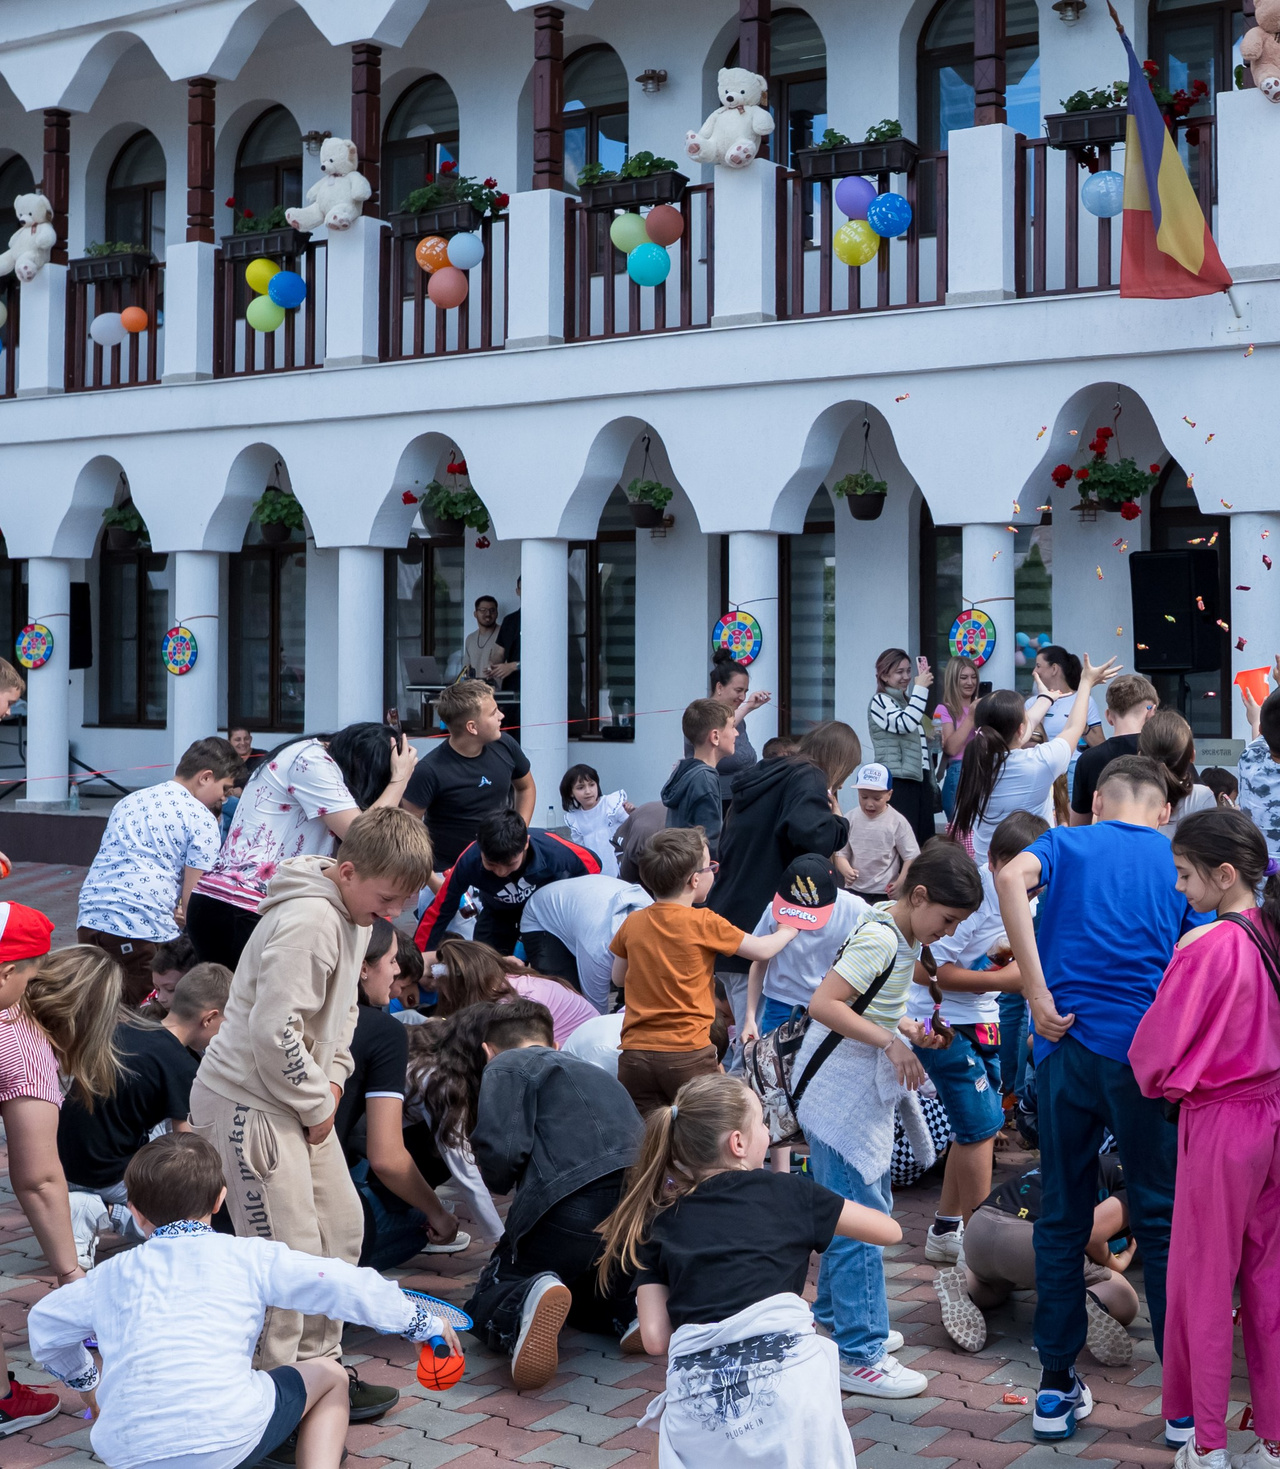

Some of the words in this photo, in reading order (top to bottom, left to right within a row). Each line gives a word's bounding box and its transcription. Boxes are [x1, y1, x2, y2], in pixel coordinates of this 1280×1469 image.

[779, 907, 817, 923] GARFIELD
[244, 1190, 272, 1237] uble
[726, 1427, 744, 1440] PLUG
[744, 1421, 754, 1431] ME
[756, 1418, 764, 1426] IN
